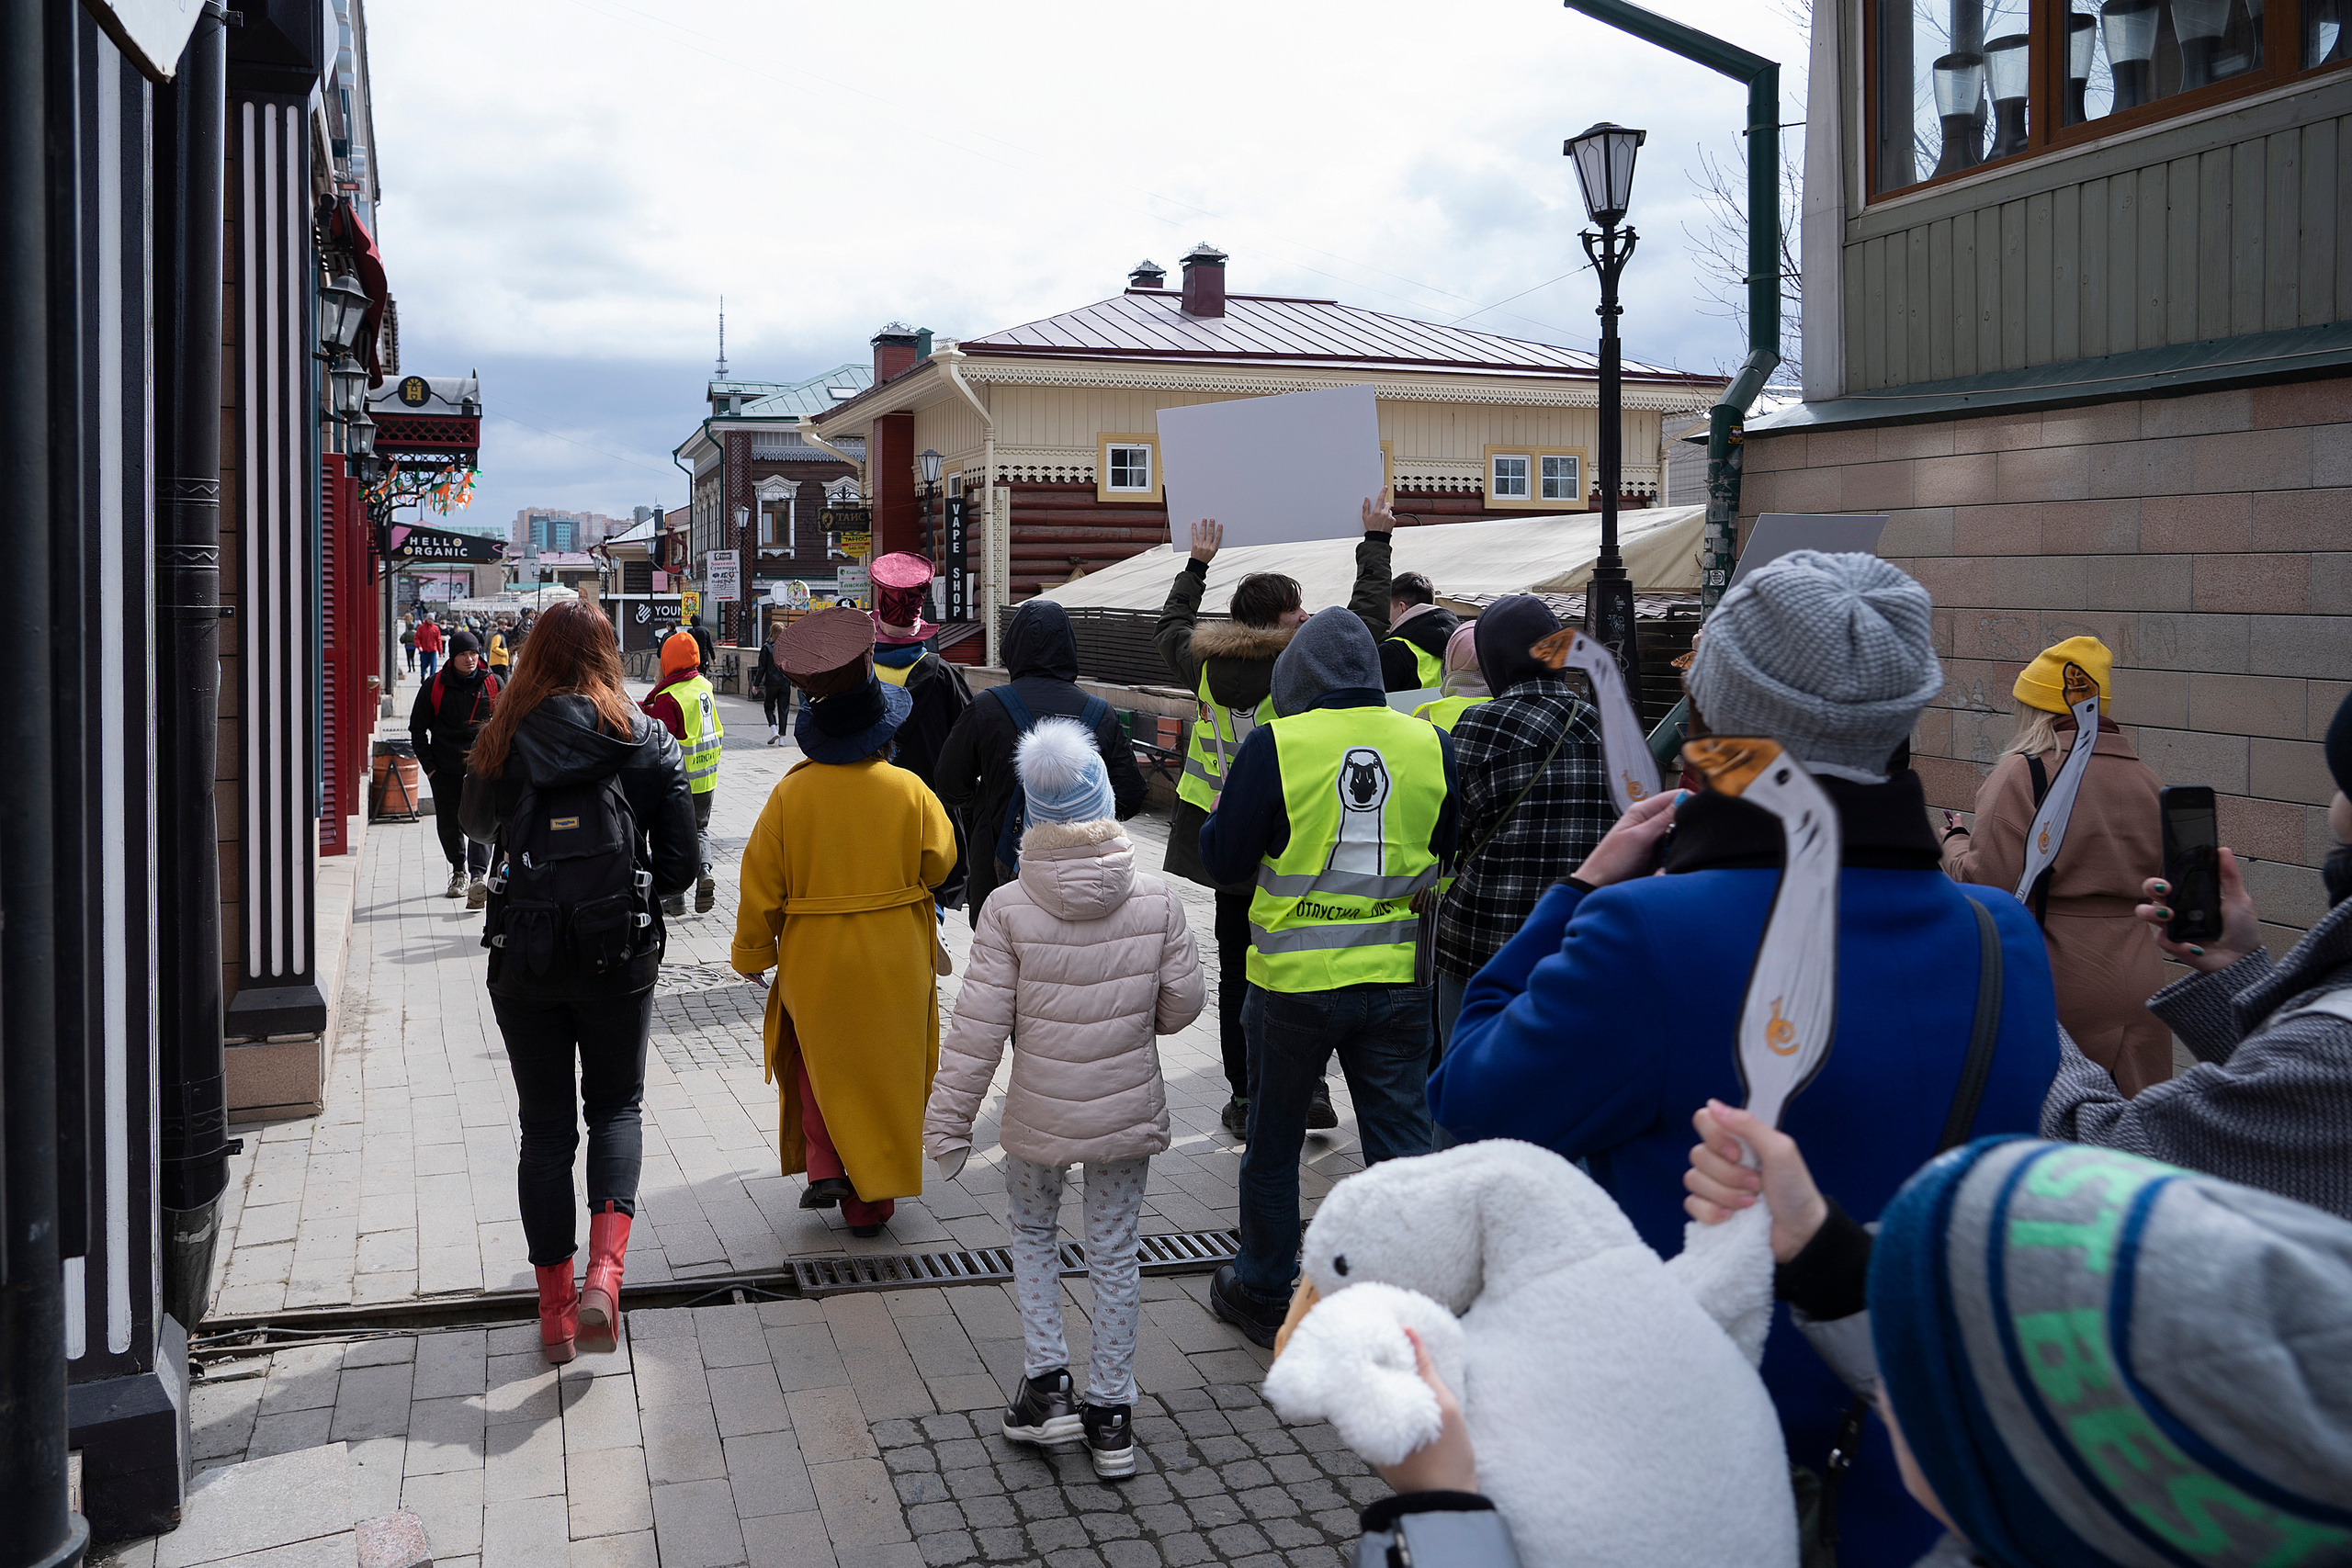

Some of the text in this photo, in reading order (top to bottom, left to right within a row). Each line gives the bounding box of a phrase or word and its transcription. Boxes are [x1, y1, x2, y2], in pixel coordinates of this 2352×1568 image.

[836, 513, 865, 522] ТАИС
[409, 536, 462, 547] HELLO
[403, 546, 469, 557] ORGANIC
[952, 503, 961, 617] VAPE SHOP
[1295, 899, 1361, 920] ОТПУСТИЛ
[2015, 1307, 2352, 1568] BEST
